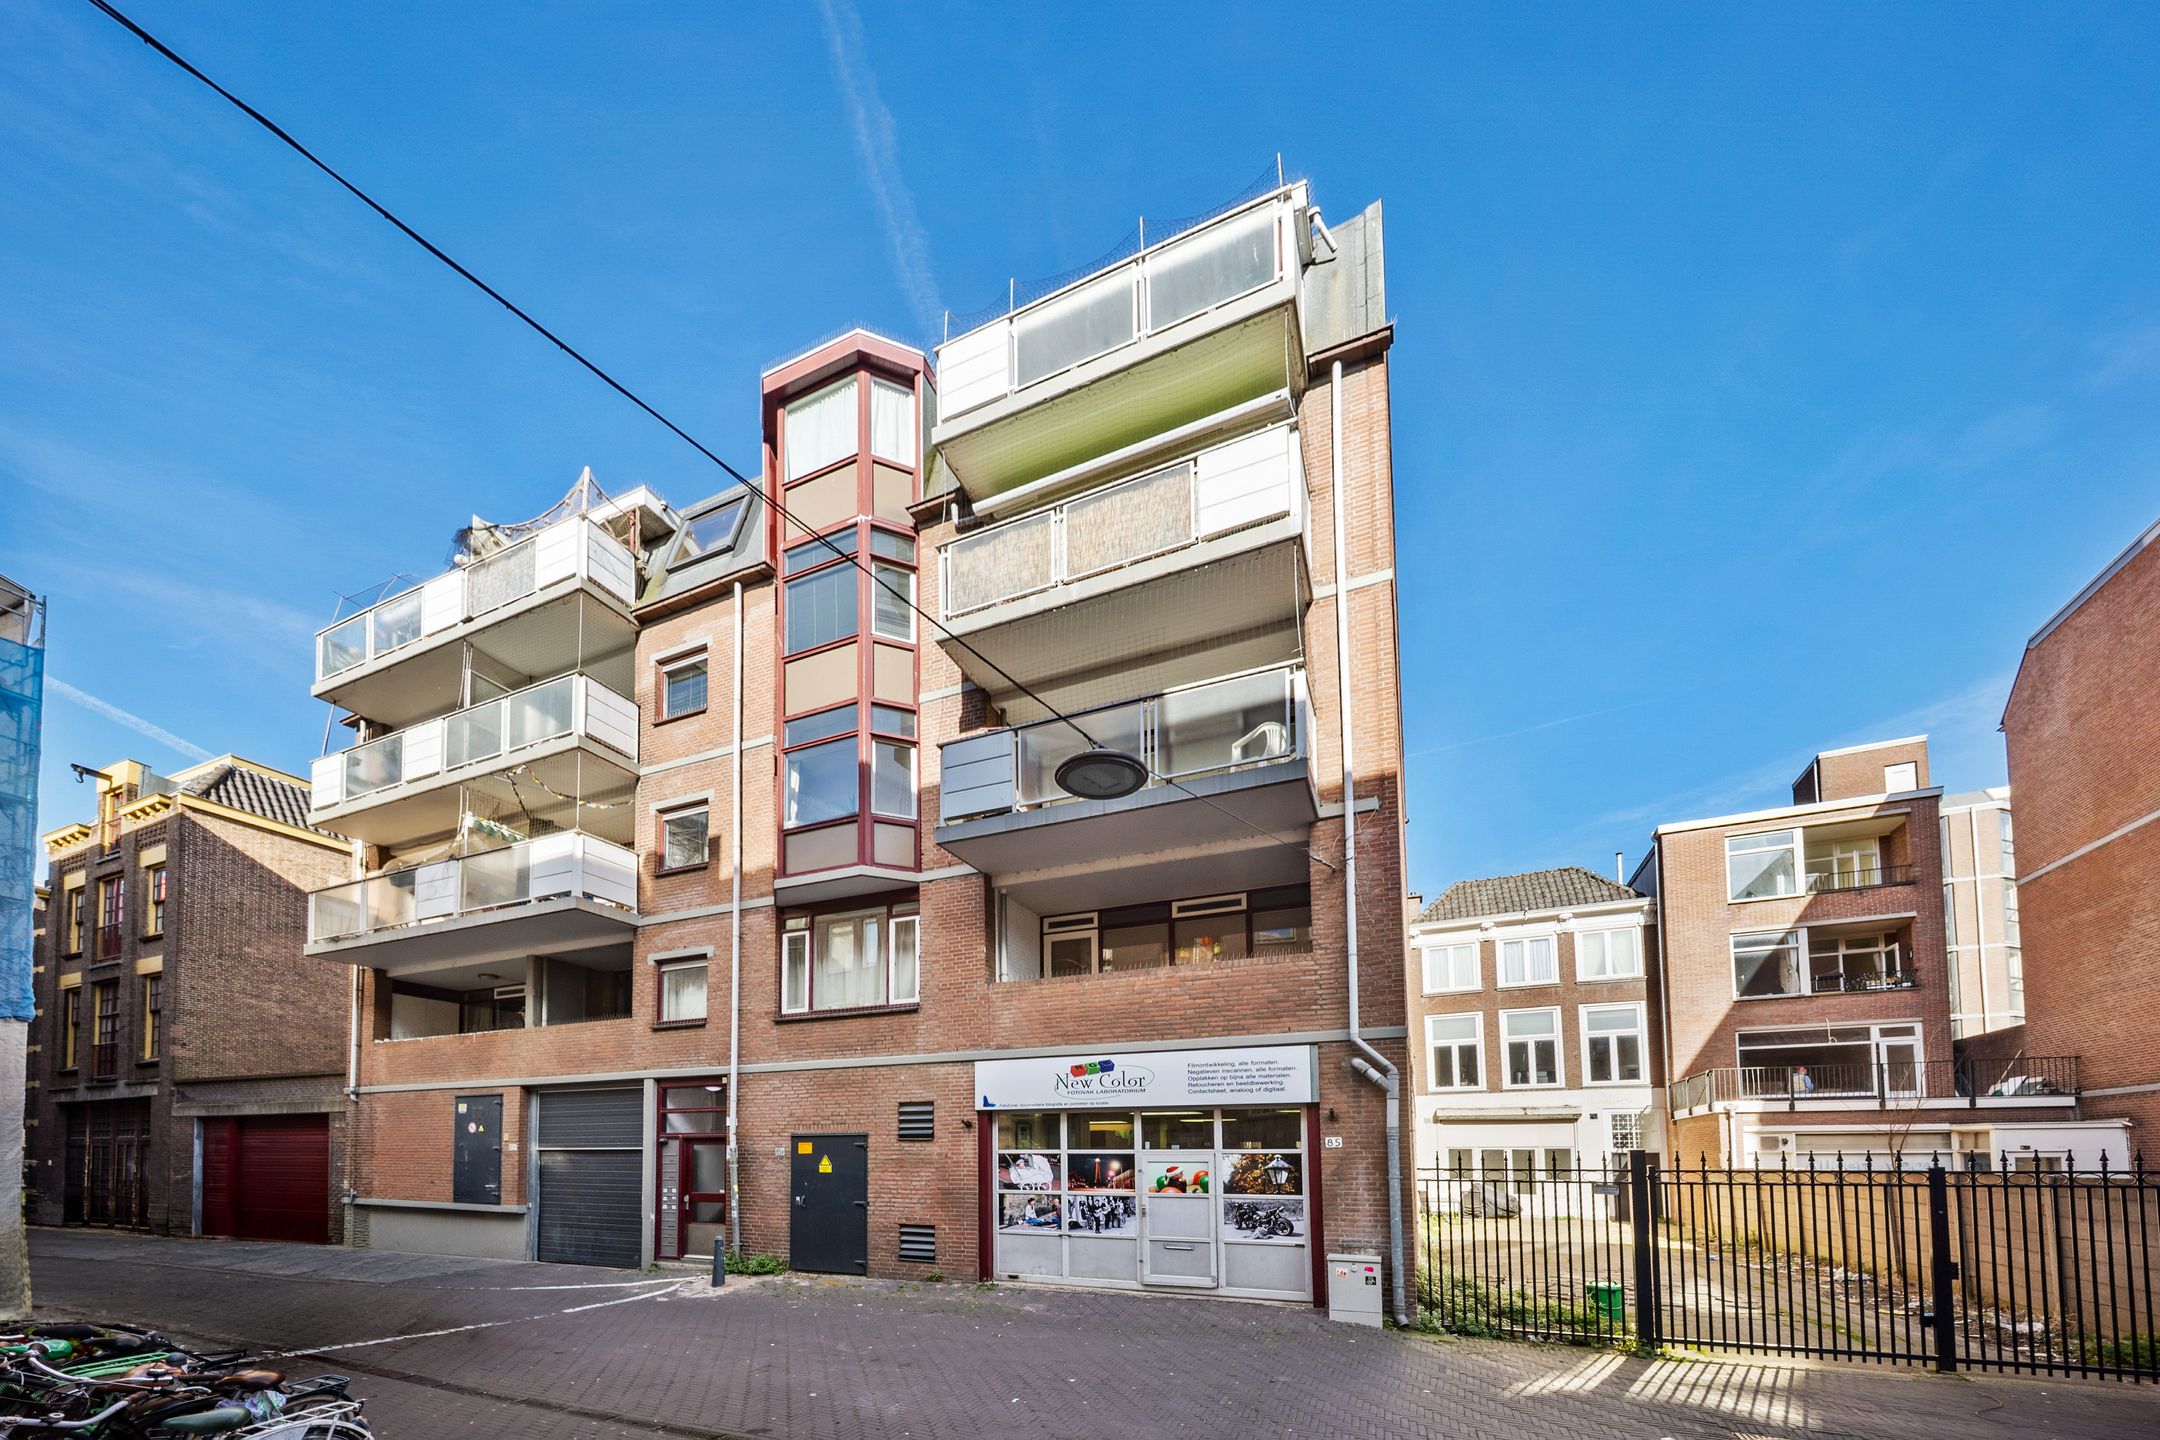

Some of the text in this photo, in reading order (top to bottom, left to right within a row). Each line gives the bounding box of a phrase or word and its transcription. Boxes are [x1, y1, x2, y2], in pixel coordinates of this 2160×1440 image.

[1055, 1070, 1146, 1090] New Color
[1327, 1138, 1341, 1147] 85
